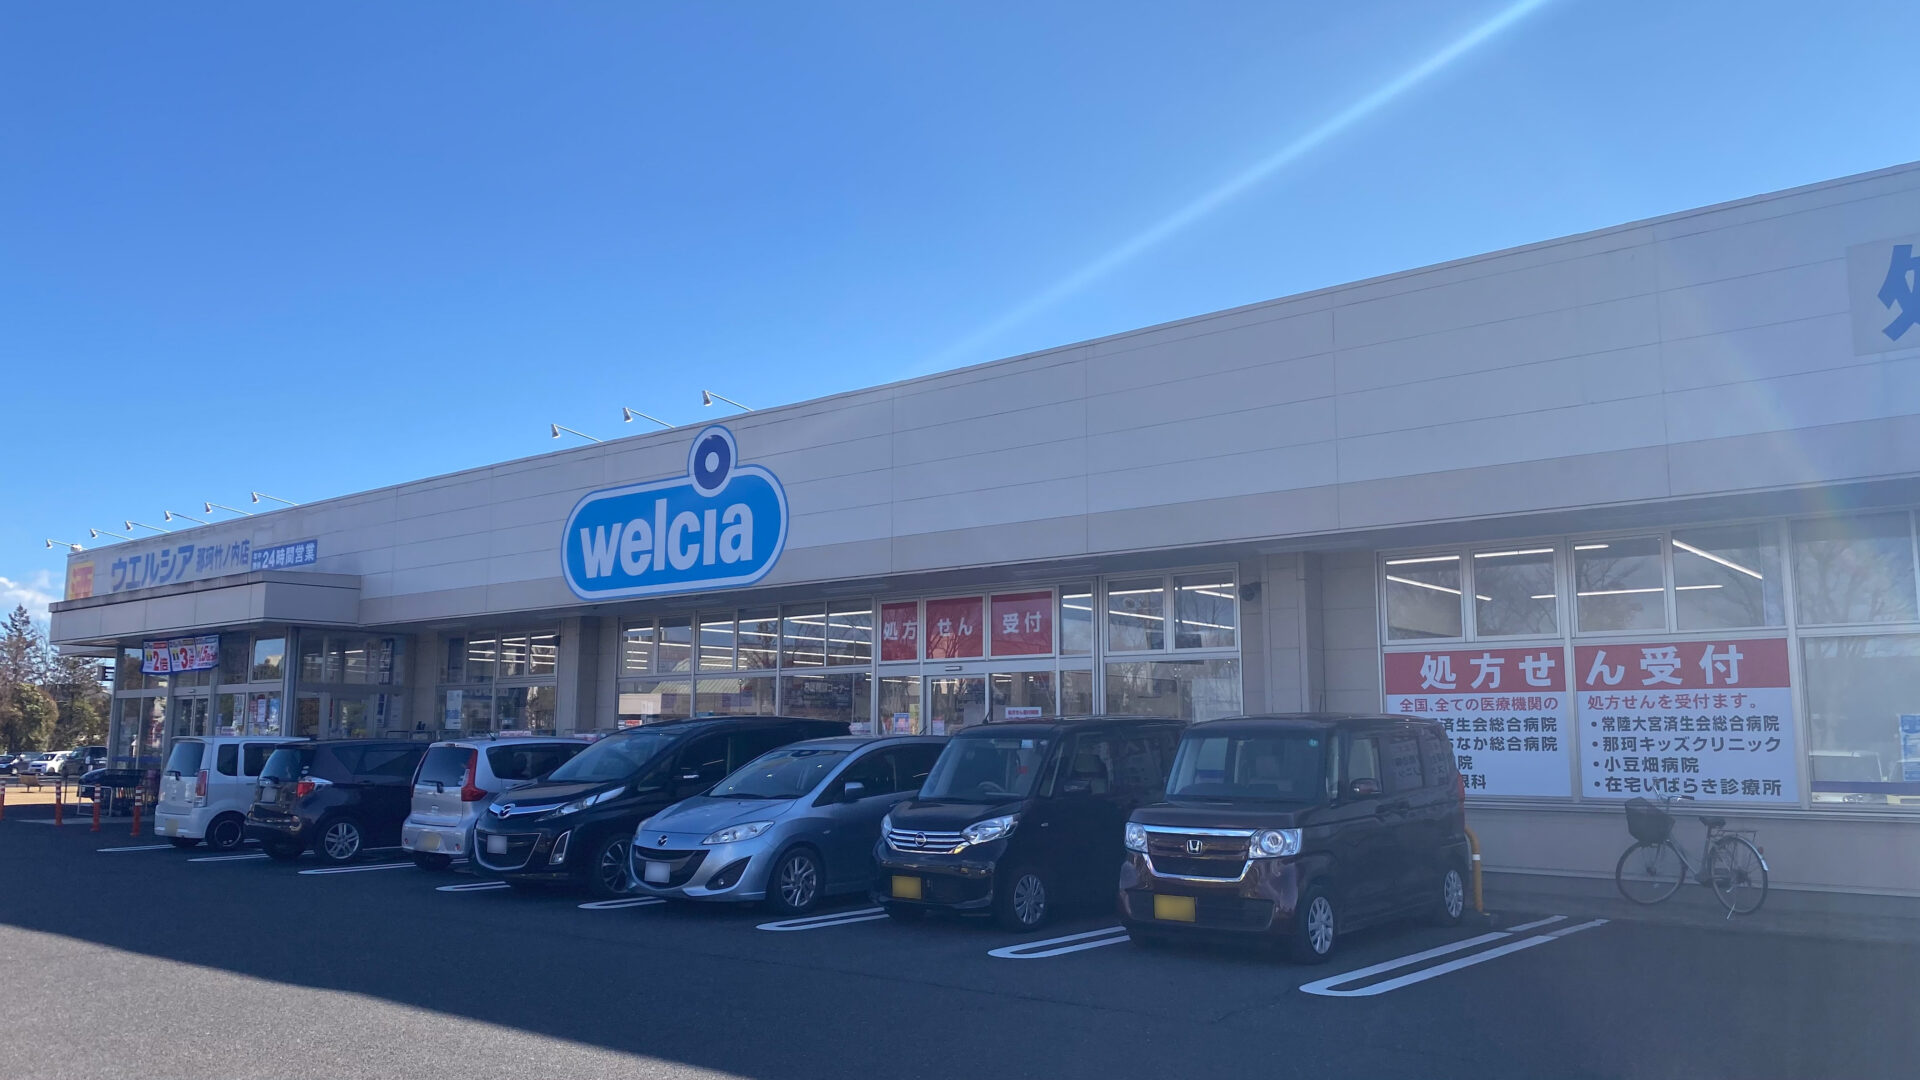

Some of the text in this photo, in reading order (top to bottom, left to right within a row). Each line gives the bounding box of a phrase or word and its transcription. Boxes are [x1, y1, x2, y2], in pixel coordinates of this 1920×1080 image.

[580, 435, 753, 579] welcia
[262, 543, 315, 569] 24時間営業
[111, 544, 195, 592] ウエルシア
[883, 612, 1041, 641] 処方 せん 受付
[1400, 697, 1558, 712] 全国、全ての医療機関の
[1587, 693, 1756, 710] 処方せんを受付ます。
[1431, 717, 1557, 732] 済生会総合病院
[1602, 715, 1780, 732] 常陸大宮済生会総合病院
[1603, 736, 1781, 753] 那珂キッズクリニック
[1604, 756, 1699, 773] 小豆畑病院
[1605, 776, 1781, 796] 在宅いばらき診療所
